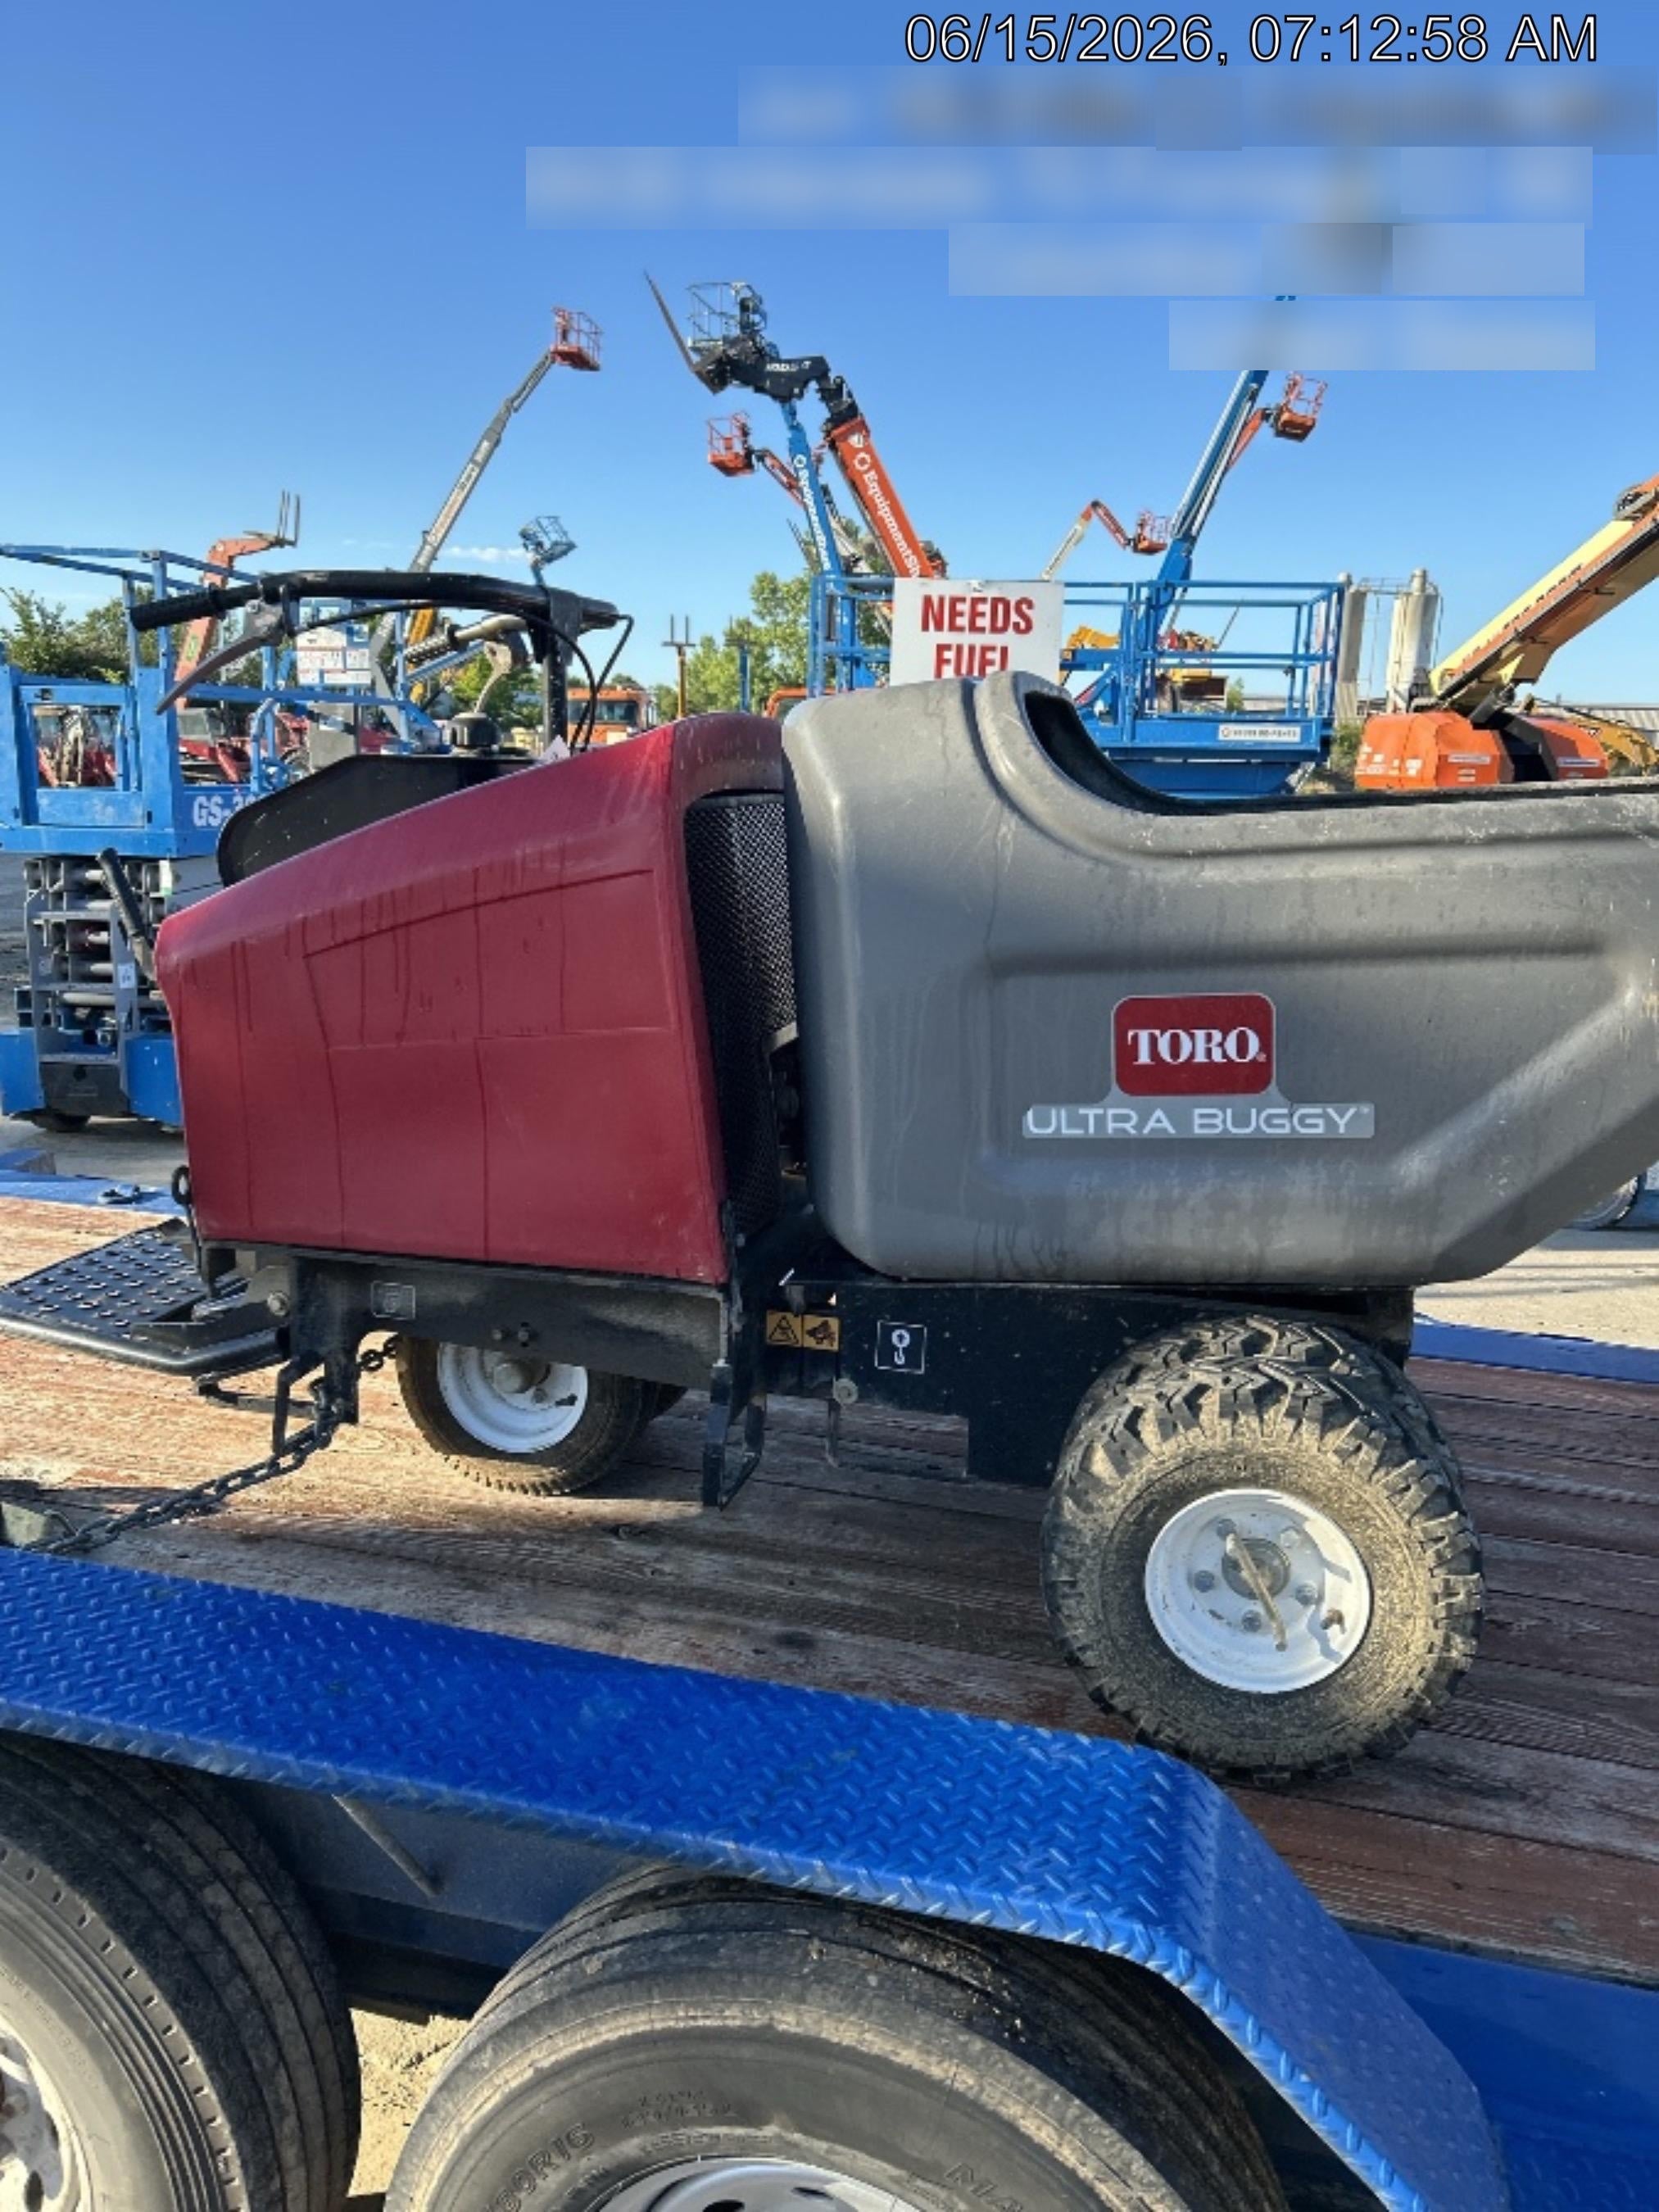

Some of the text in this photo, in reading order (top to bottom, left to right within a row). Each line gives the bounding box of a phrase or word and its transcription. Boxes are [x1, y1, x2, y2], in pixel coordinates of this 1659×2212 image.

[921, 595, 1035, 634] NEEDS
[1127, 1026, 1261, 1065] TORO
[1027, 1107, 1358, 1135] ULTRA BUGGY
